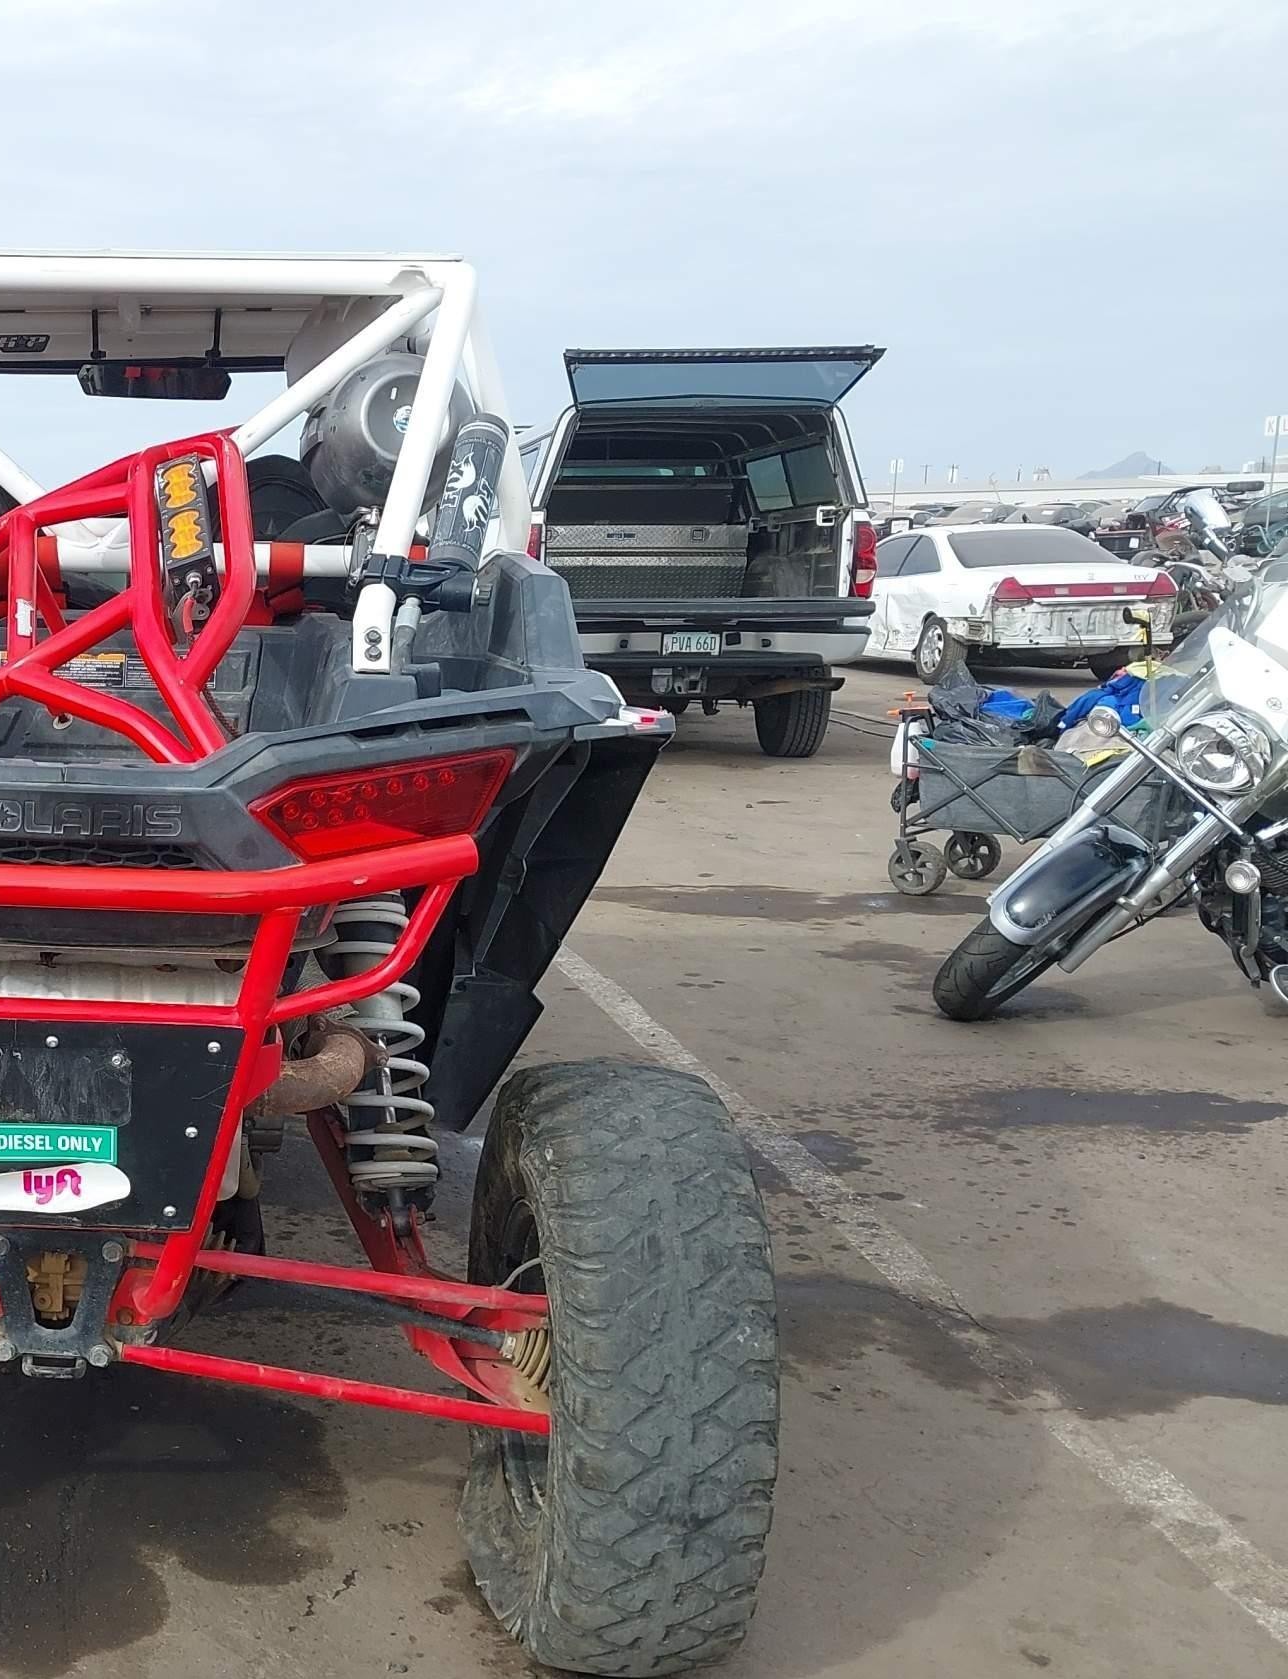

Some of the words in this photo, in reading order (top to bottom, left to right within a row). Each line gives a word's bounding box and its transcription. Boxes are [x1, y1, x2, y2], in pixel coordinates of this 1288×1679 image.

[672, 636, 692, 651] PVA
[696, 636, 717, 651] 66D
[57, 1135, 103, 1153] ONLY
[23, 1168, 82, 1205] lyft
